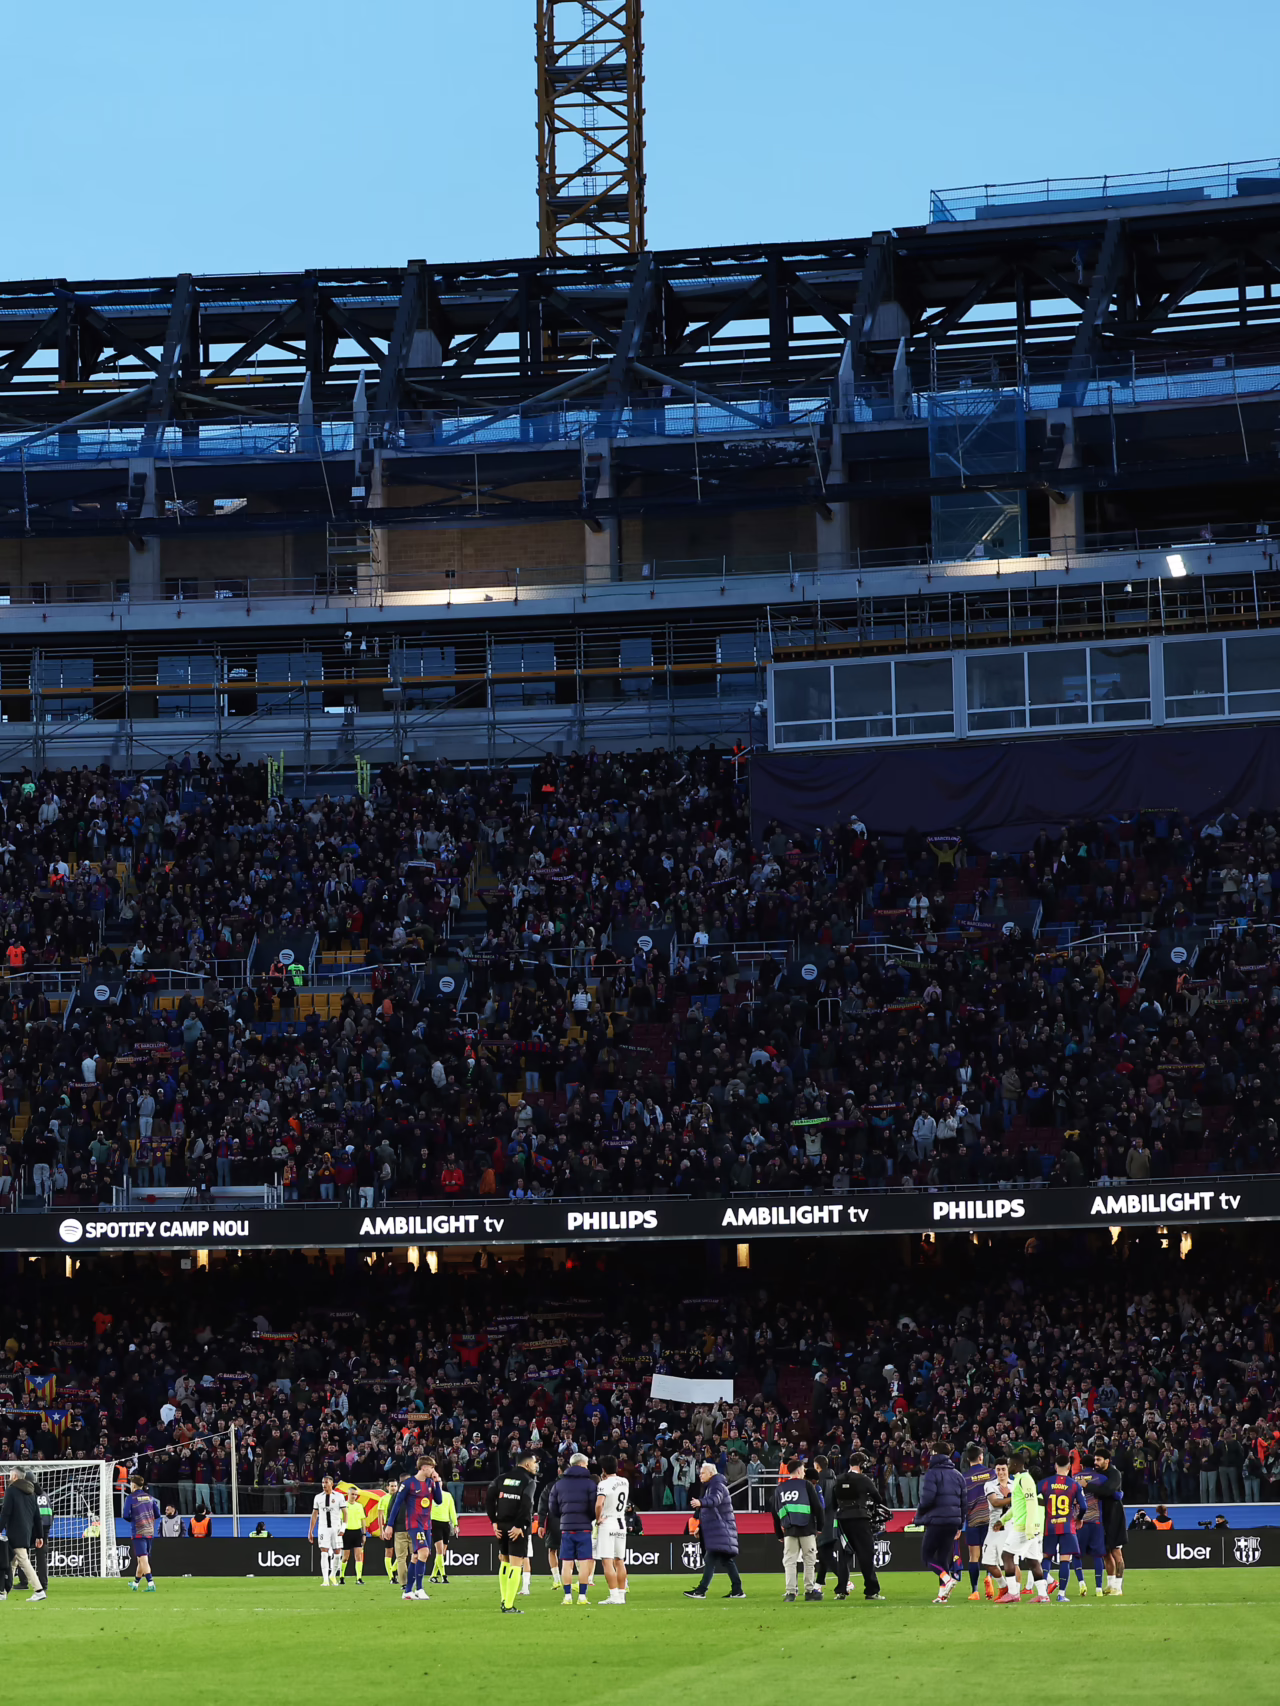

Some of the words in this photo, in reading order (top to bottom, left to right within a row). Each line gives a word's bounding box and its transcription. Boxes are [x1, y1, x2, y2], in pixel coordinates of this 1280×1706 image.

[934, 1199, 1025, 1220] PHILIPS
[1091, 1192, 1214, 1215] AMBILIGHT
[1219, 1193, 1241, 1209] tv
[360, 1215, 479, 1235] AMBILIGHT
[484, 1216, 504, 1232] tv
[568, 1210, 657, 1230] PHILIPS
[722, 1205, 843, 1226] AMBILIGHT
[848, 1206, 869, 1222] tv
[86, 1222, 156, 1239] SPOTIFY
[160, 1221, 209, 1238] CAMP
[213, 1221, 248, 1237] NOU
[840, 1379, 847, 1390] 8
[37, 1495, 48, 1505] 68
[616, 1492, 625, 1512] 8
[780, 1490, 799, 1502] 169
[1049, 1494, 1070, 1516] 19
[416, 1531, 426, 1541] 43
[258, 1551, 300, 1567] Uber
[1167, 1543, 1211, 1559] Uber
